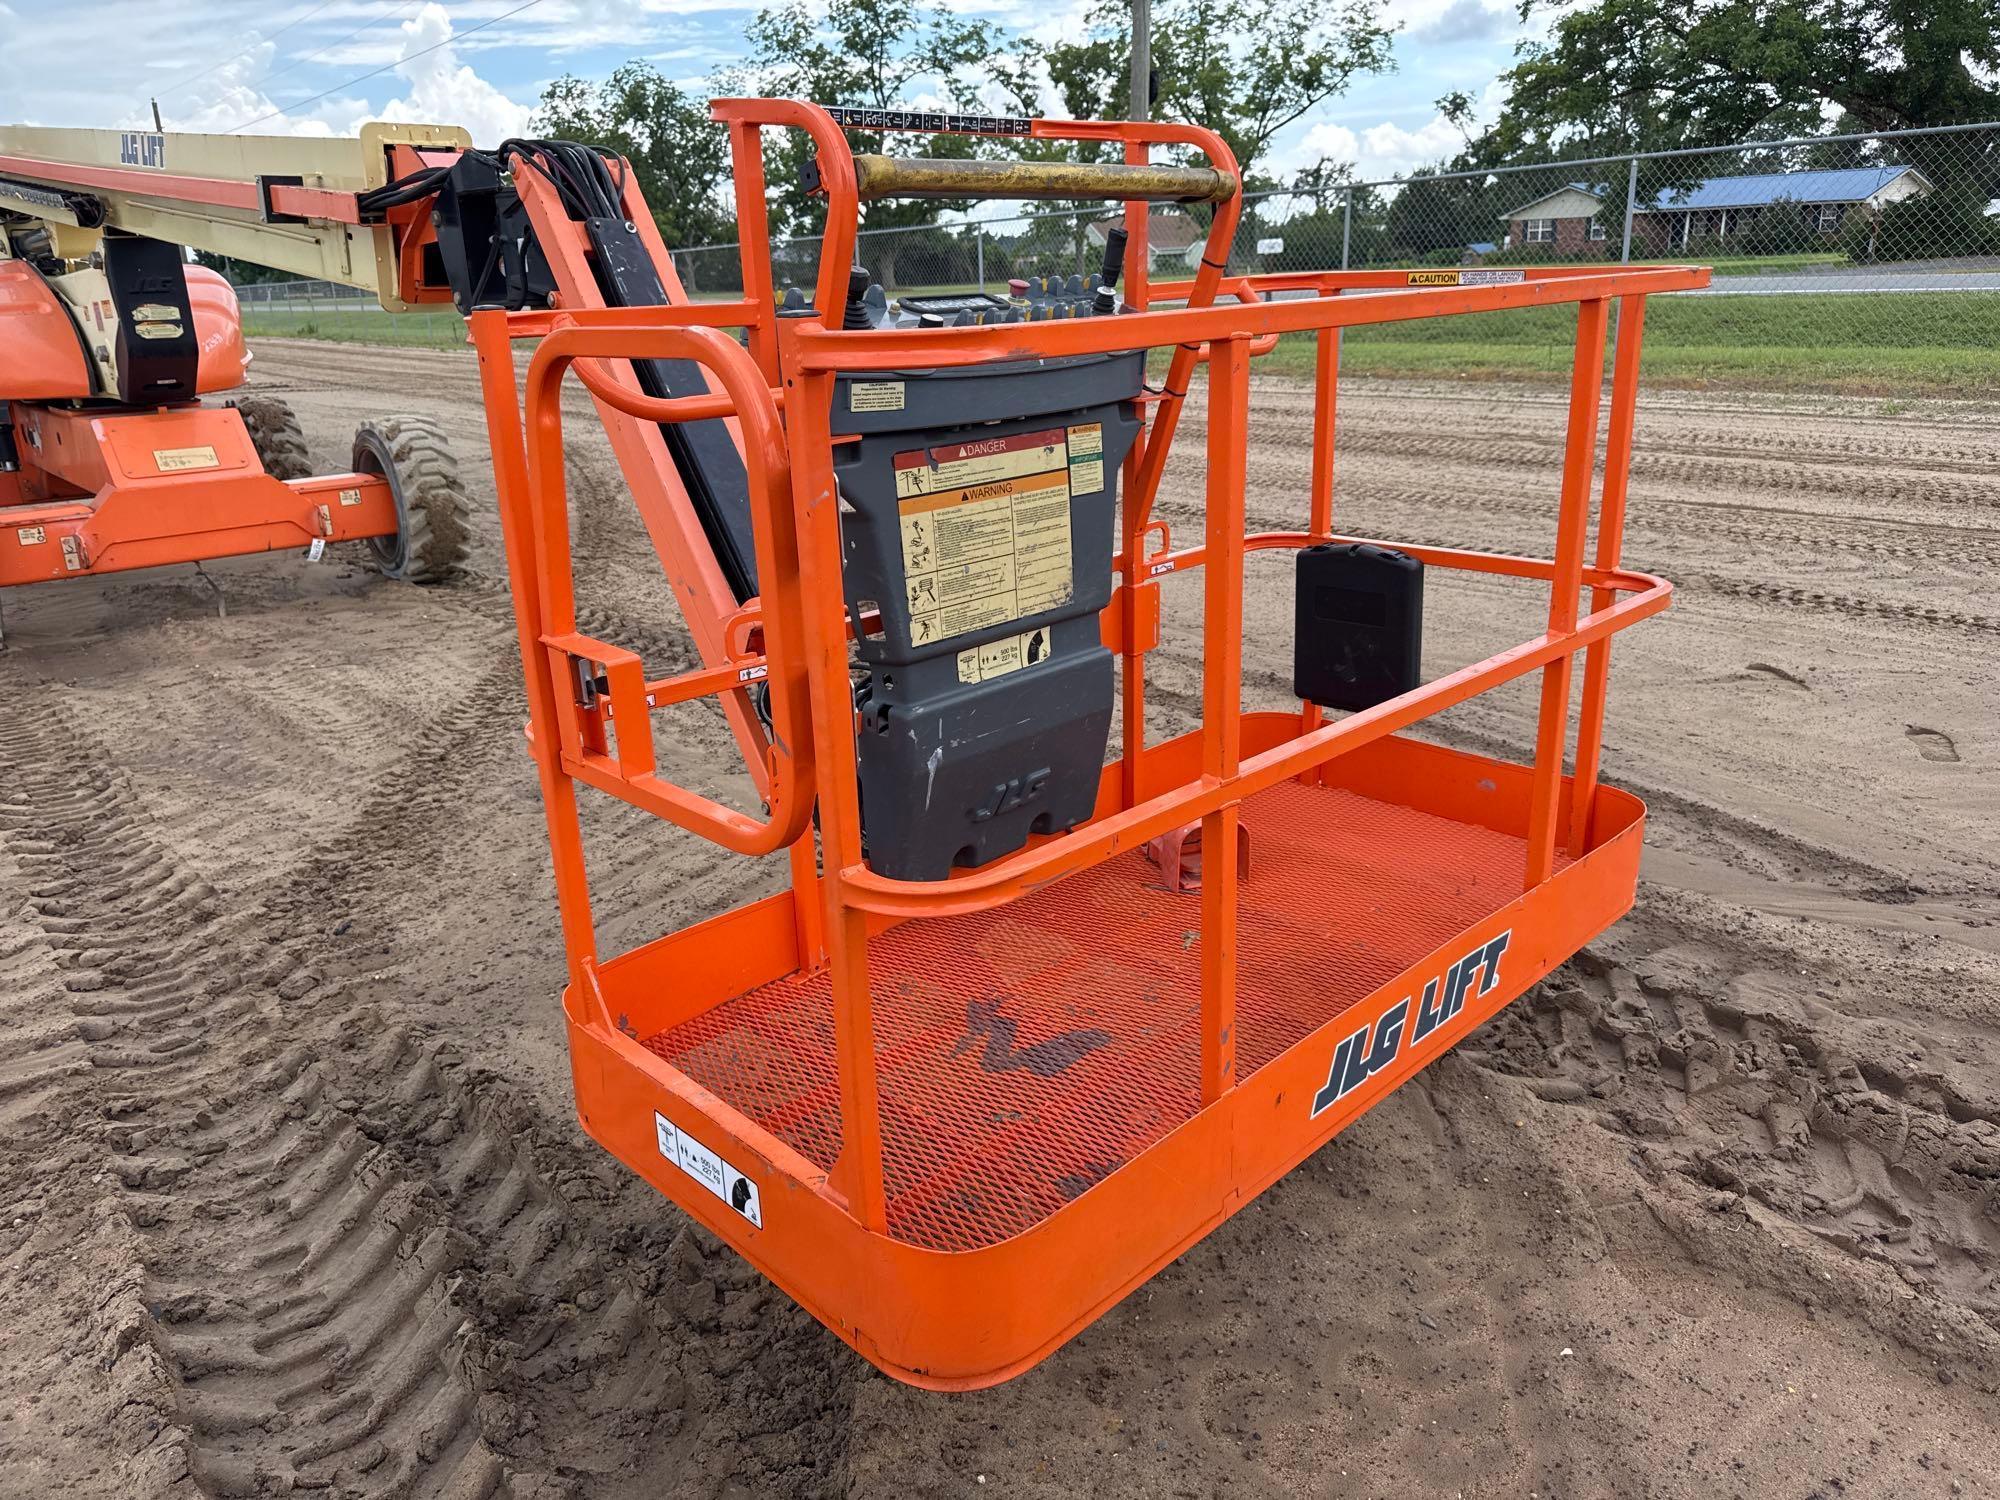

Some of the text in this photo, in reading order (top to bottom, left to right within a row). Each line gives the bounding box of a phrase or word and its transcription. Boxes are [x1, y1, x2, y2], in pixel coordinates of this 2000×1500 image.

[120, 133, 165, 169] JLG LIFT
[1419, 274, 1457, 284] CAUTION
[967, 440, 1007, 456] DANGER
[969, 482, 1013, 500] WARNING
[974, 766, 1052, 819] JLG
[1309, 928, 1512, 1121] JLG LIFT
